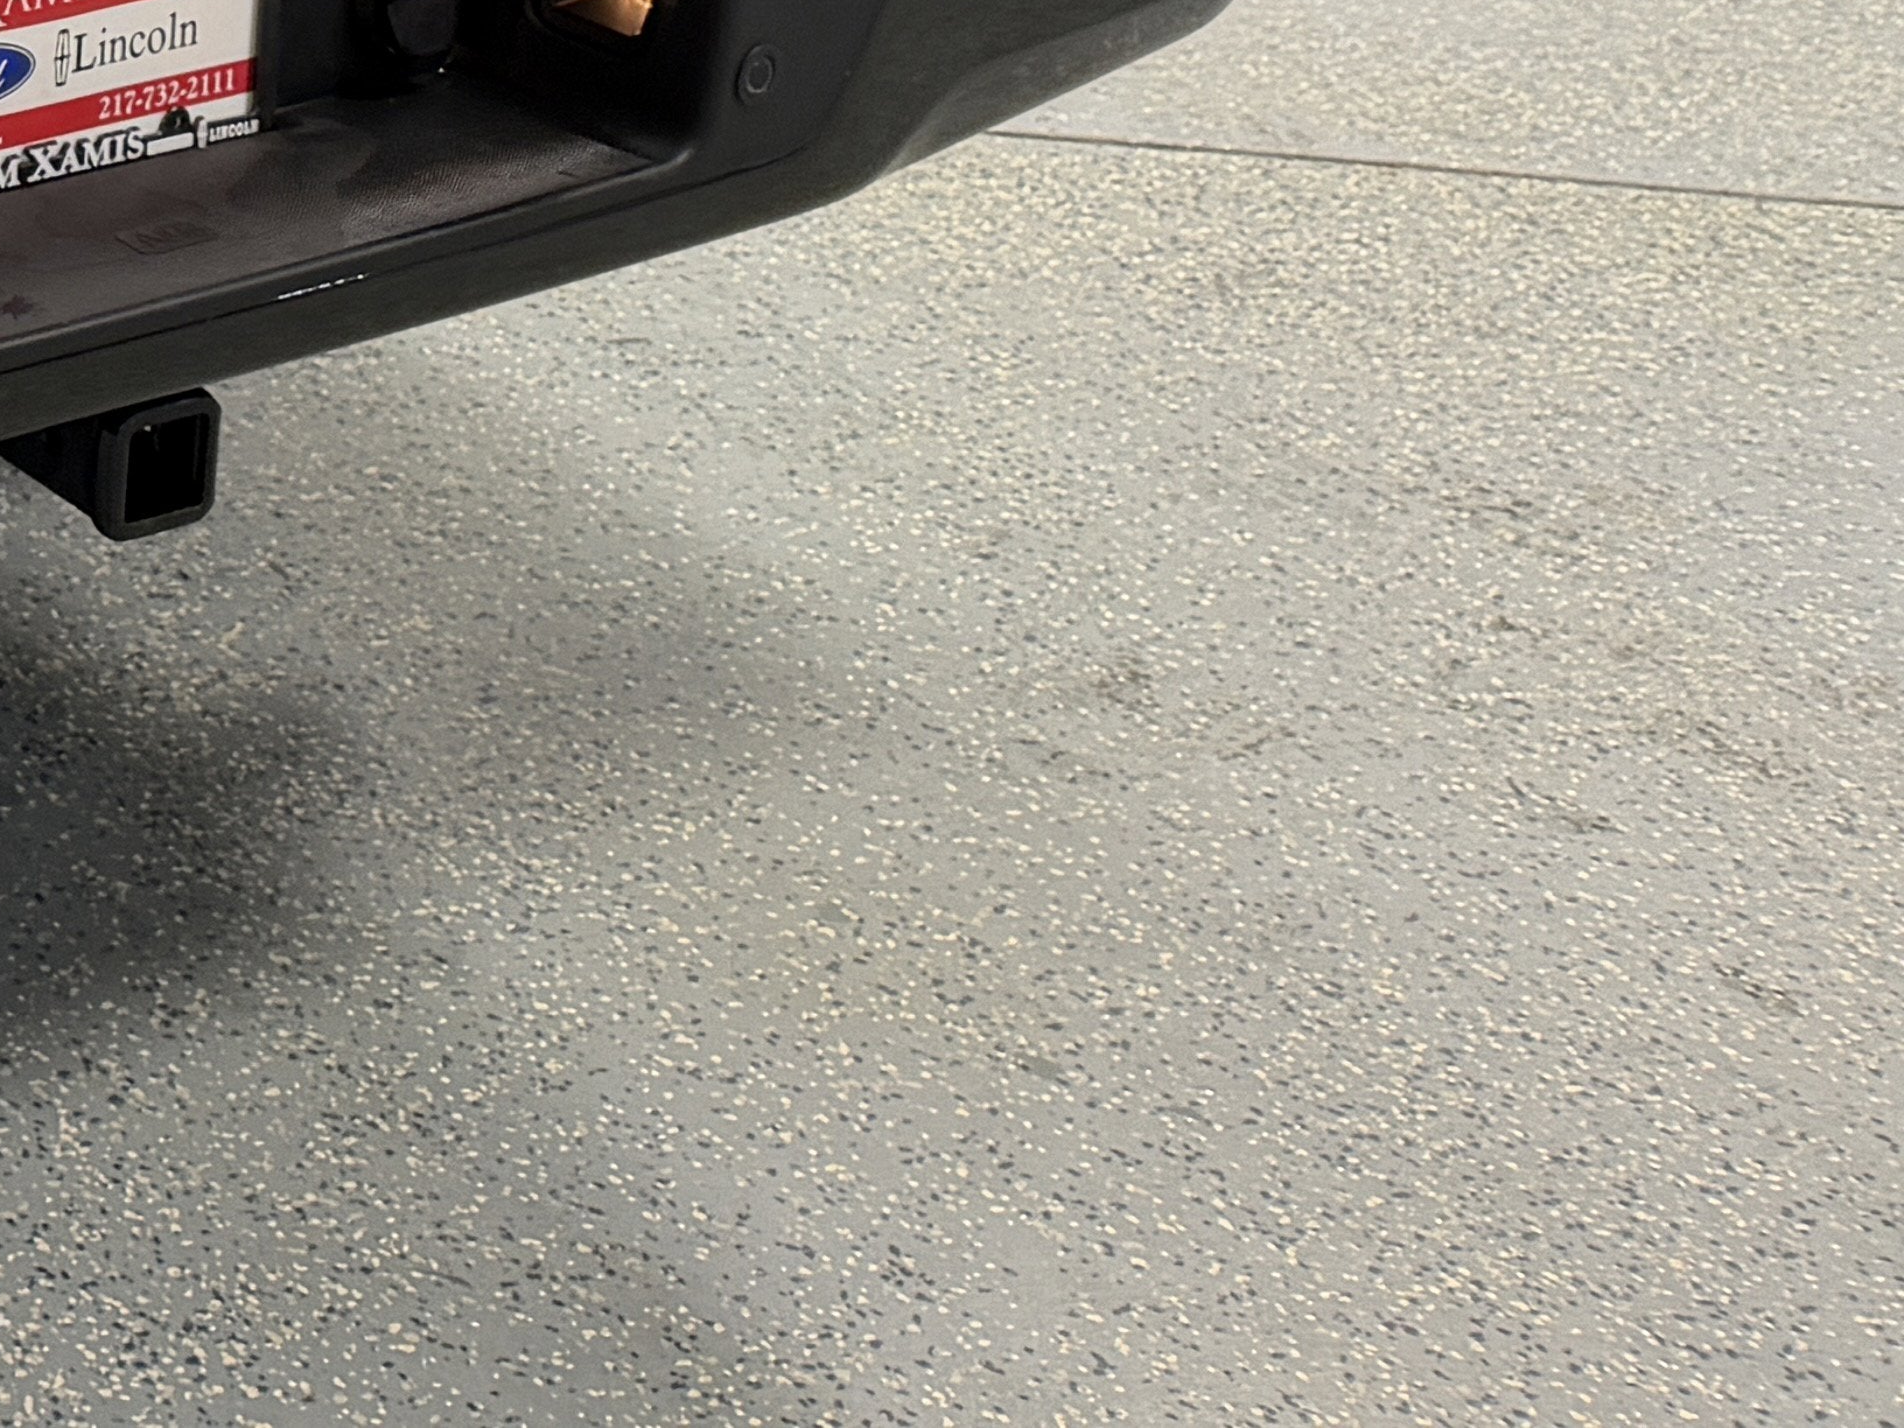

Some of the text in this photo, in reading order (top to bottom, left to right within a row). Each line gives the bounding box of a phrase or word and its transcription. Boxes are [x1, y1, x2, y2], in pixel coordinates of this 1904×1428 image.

[71, 12, 199, 75] Lincoln
[98, 67, 235, 121] 217-732-2111
[27, 128, 146, 185] XAMIS
